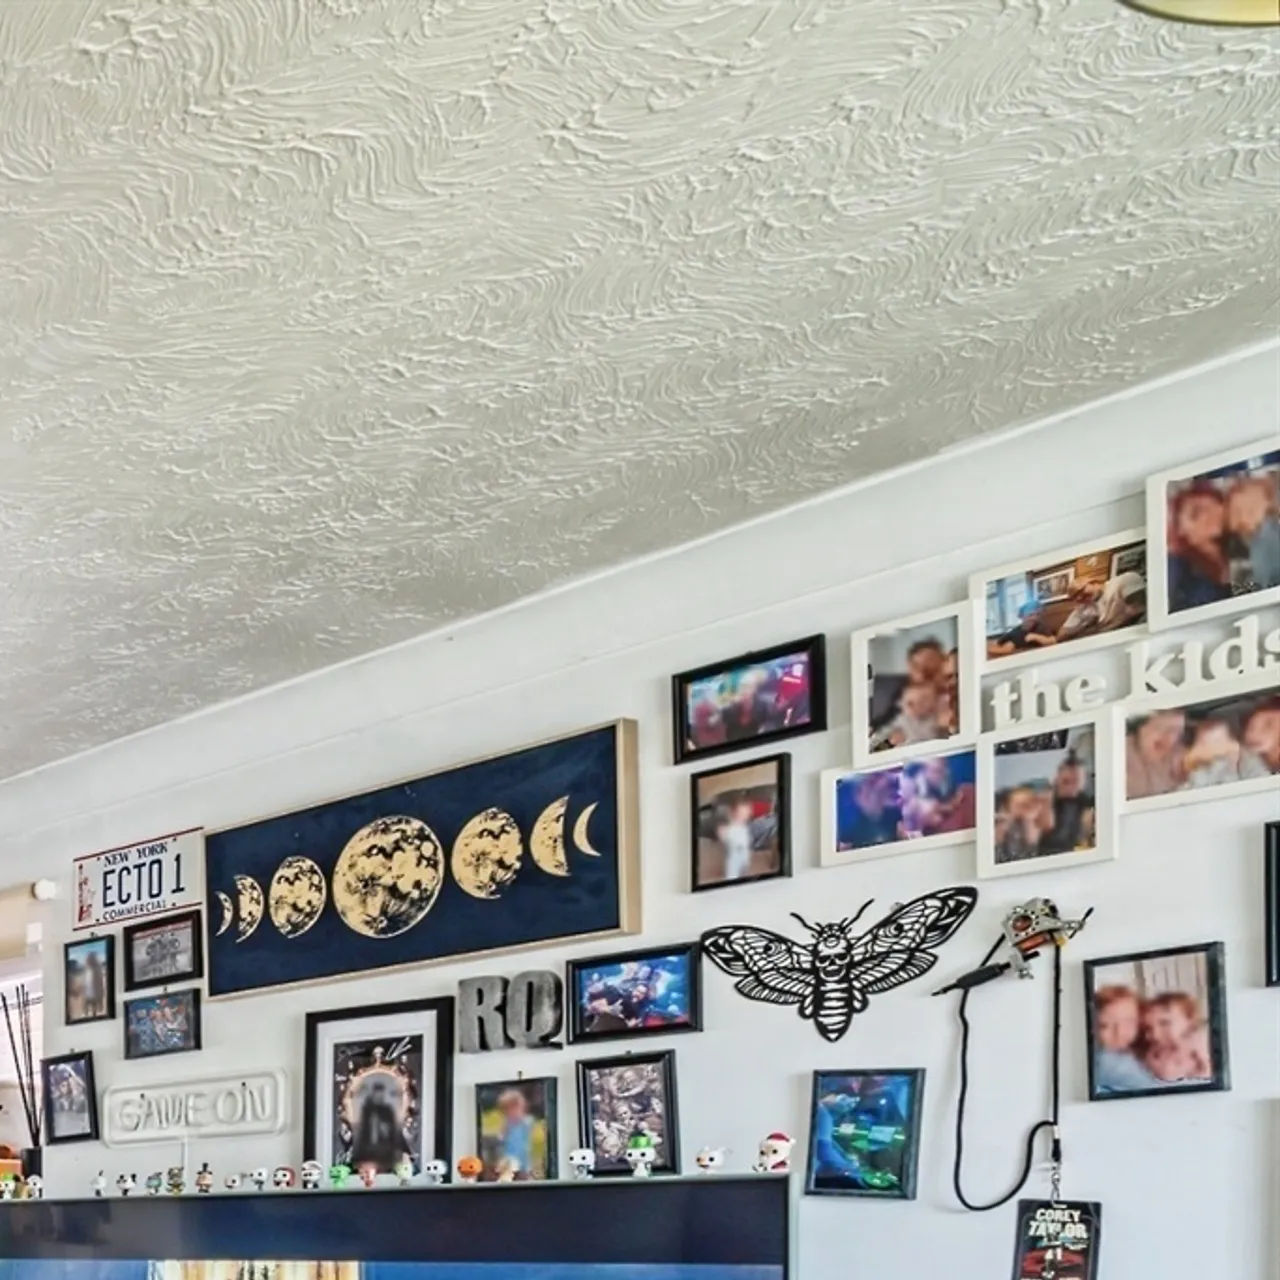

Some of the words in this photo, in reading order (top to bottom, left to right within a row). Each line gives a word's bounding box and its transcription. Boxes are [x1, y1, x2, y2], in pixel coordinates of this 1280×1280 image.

[990, 668, 1107, 725] the
[103, 850, 131, 867] NEW
[136, 841, 169, 860] YORK
[102, 857, 163, 908] ECTO
[170, 852, 186, 894] 1
[102, 899, 168, 922] COMMERCIAL
[458, 970, 564, 1053] RQ
[119, 1092, 210, 1132] GAME
[214, 1084, 271, 1125] ON
[1035, 1207, 1082, 1223] COREY
